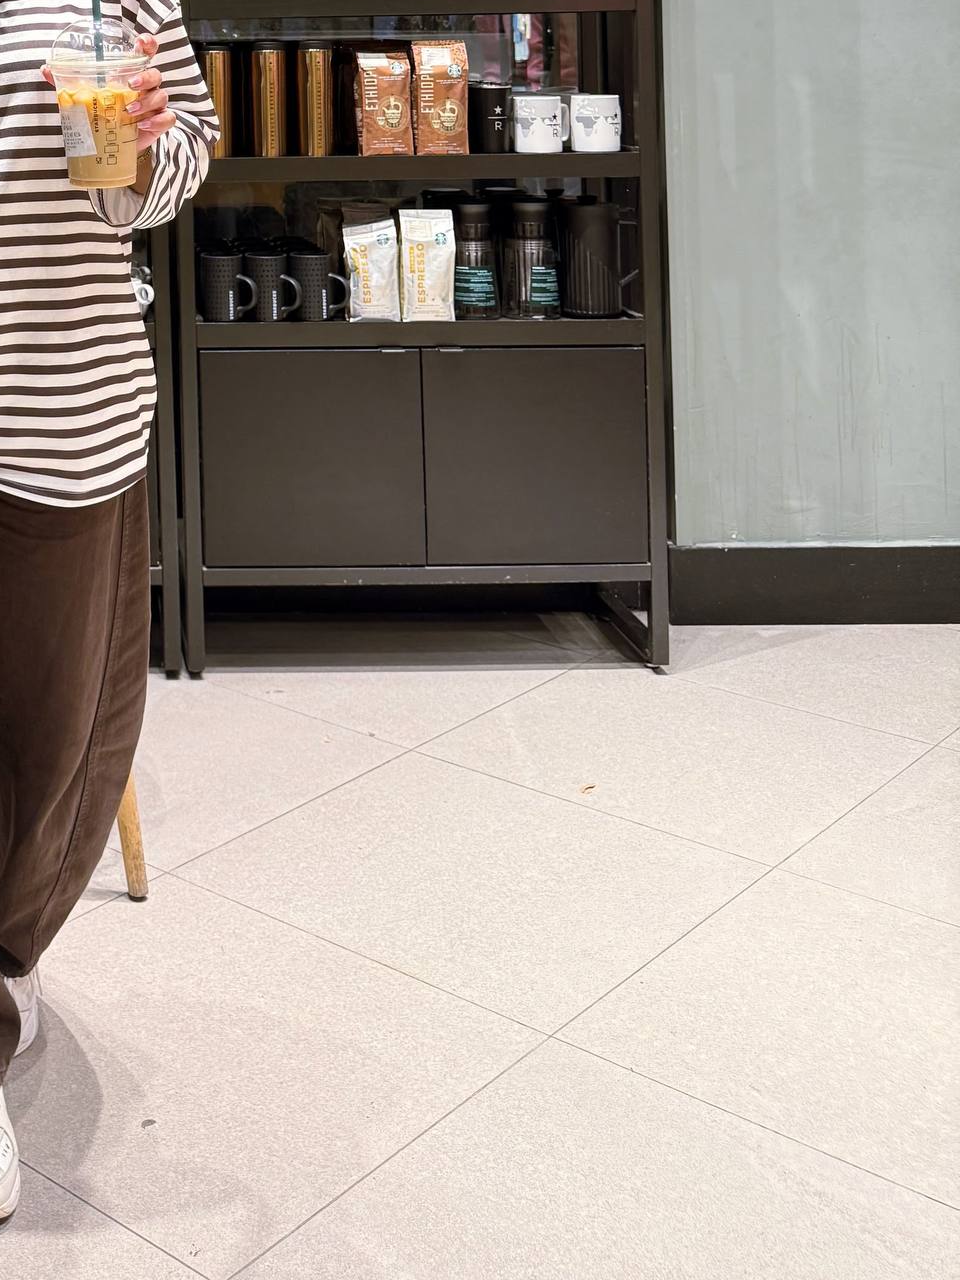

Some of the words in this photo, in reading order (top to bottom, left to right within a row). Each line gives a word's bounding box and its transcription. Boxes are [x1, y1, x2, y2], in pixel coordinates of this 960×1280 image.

[363, 67, 379, 111] ETHIOPI
[494, 121, 503, 131] R
[552, 128, 560, 137] R
[416, 243, 426, 304] ESPRESSO
